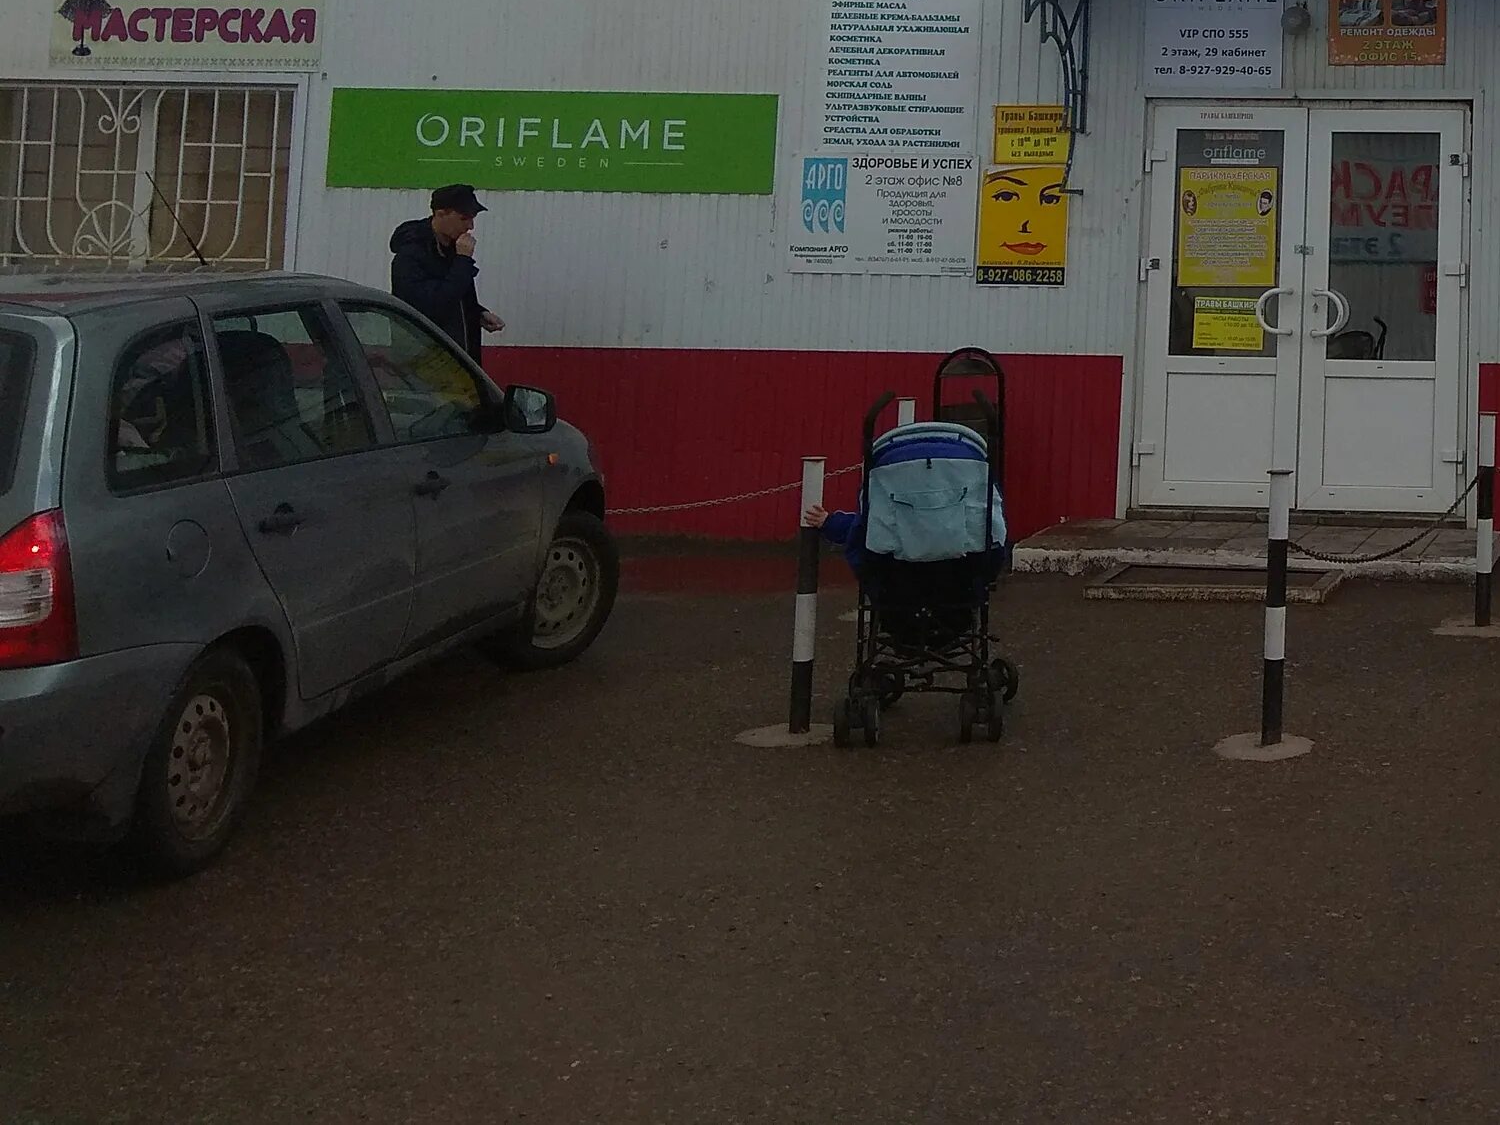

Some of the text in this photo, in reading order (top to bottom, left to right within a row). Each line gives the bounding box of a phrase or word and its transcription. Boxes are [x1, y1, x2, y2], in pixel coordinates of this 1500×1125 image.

[72, 8, 316, 43] МАСТЕРСКАЯ
[1179, 29, 1248, 38] VIP СПО 555
[1387, 28, 1435, 36] ОДЕЖДЫ
[1363, 40, 1413, 49] 2 ЭТАЖ
[1161, 47, 1266, 58] 2 этаж, 29 кабинет
[1359, 53, 1397, 61] ОФИС
[1179, 66, 1271, 75] 8-927-929-40-65
[416, 112, 687, 151] ORIFLAME
[1203, 144, 1266, 160] oriflame
[495, 156, 609, 169] SWEDEN
[852, 158, 972, 170] ЗДОРОВЬЕ И УСПЕХ
[865, 175, 872, 185] 2
[875, 177, 904, 186] этаж
[907, 176, 940, 188] офис
[977, 269, 1063, 283] 8-927-086-2258
